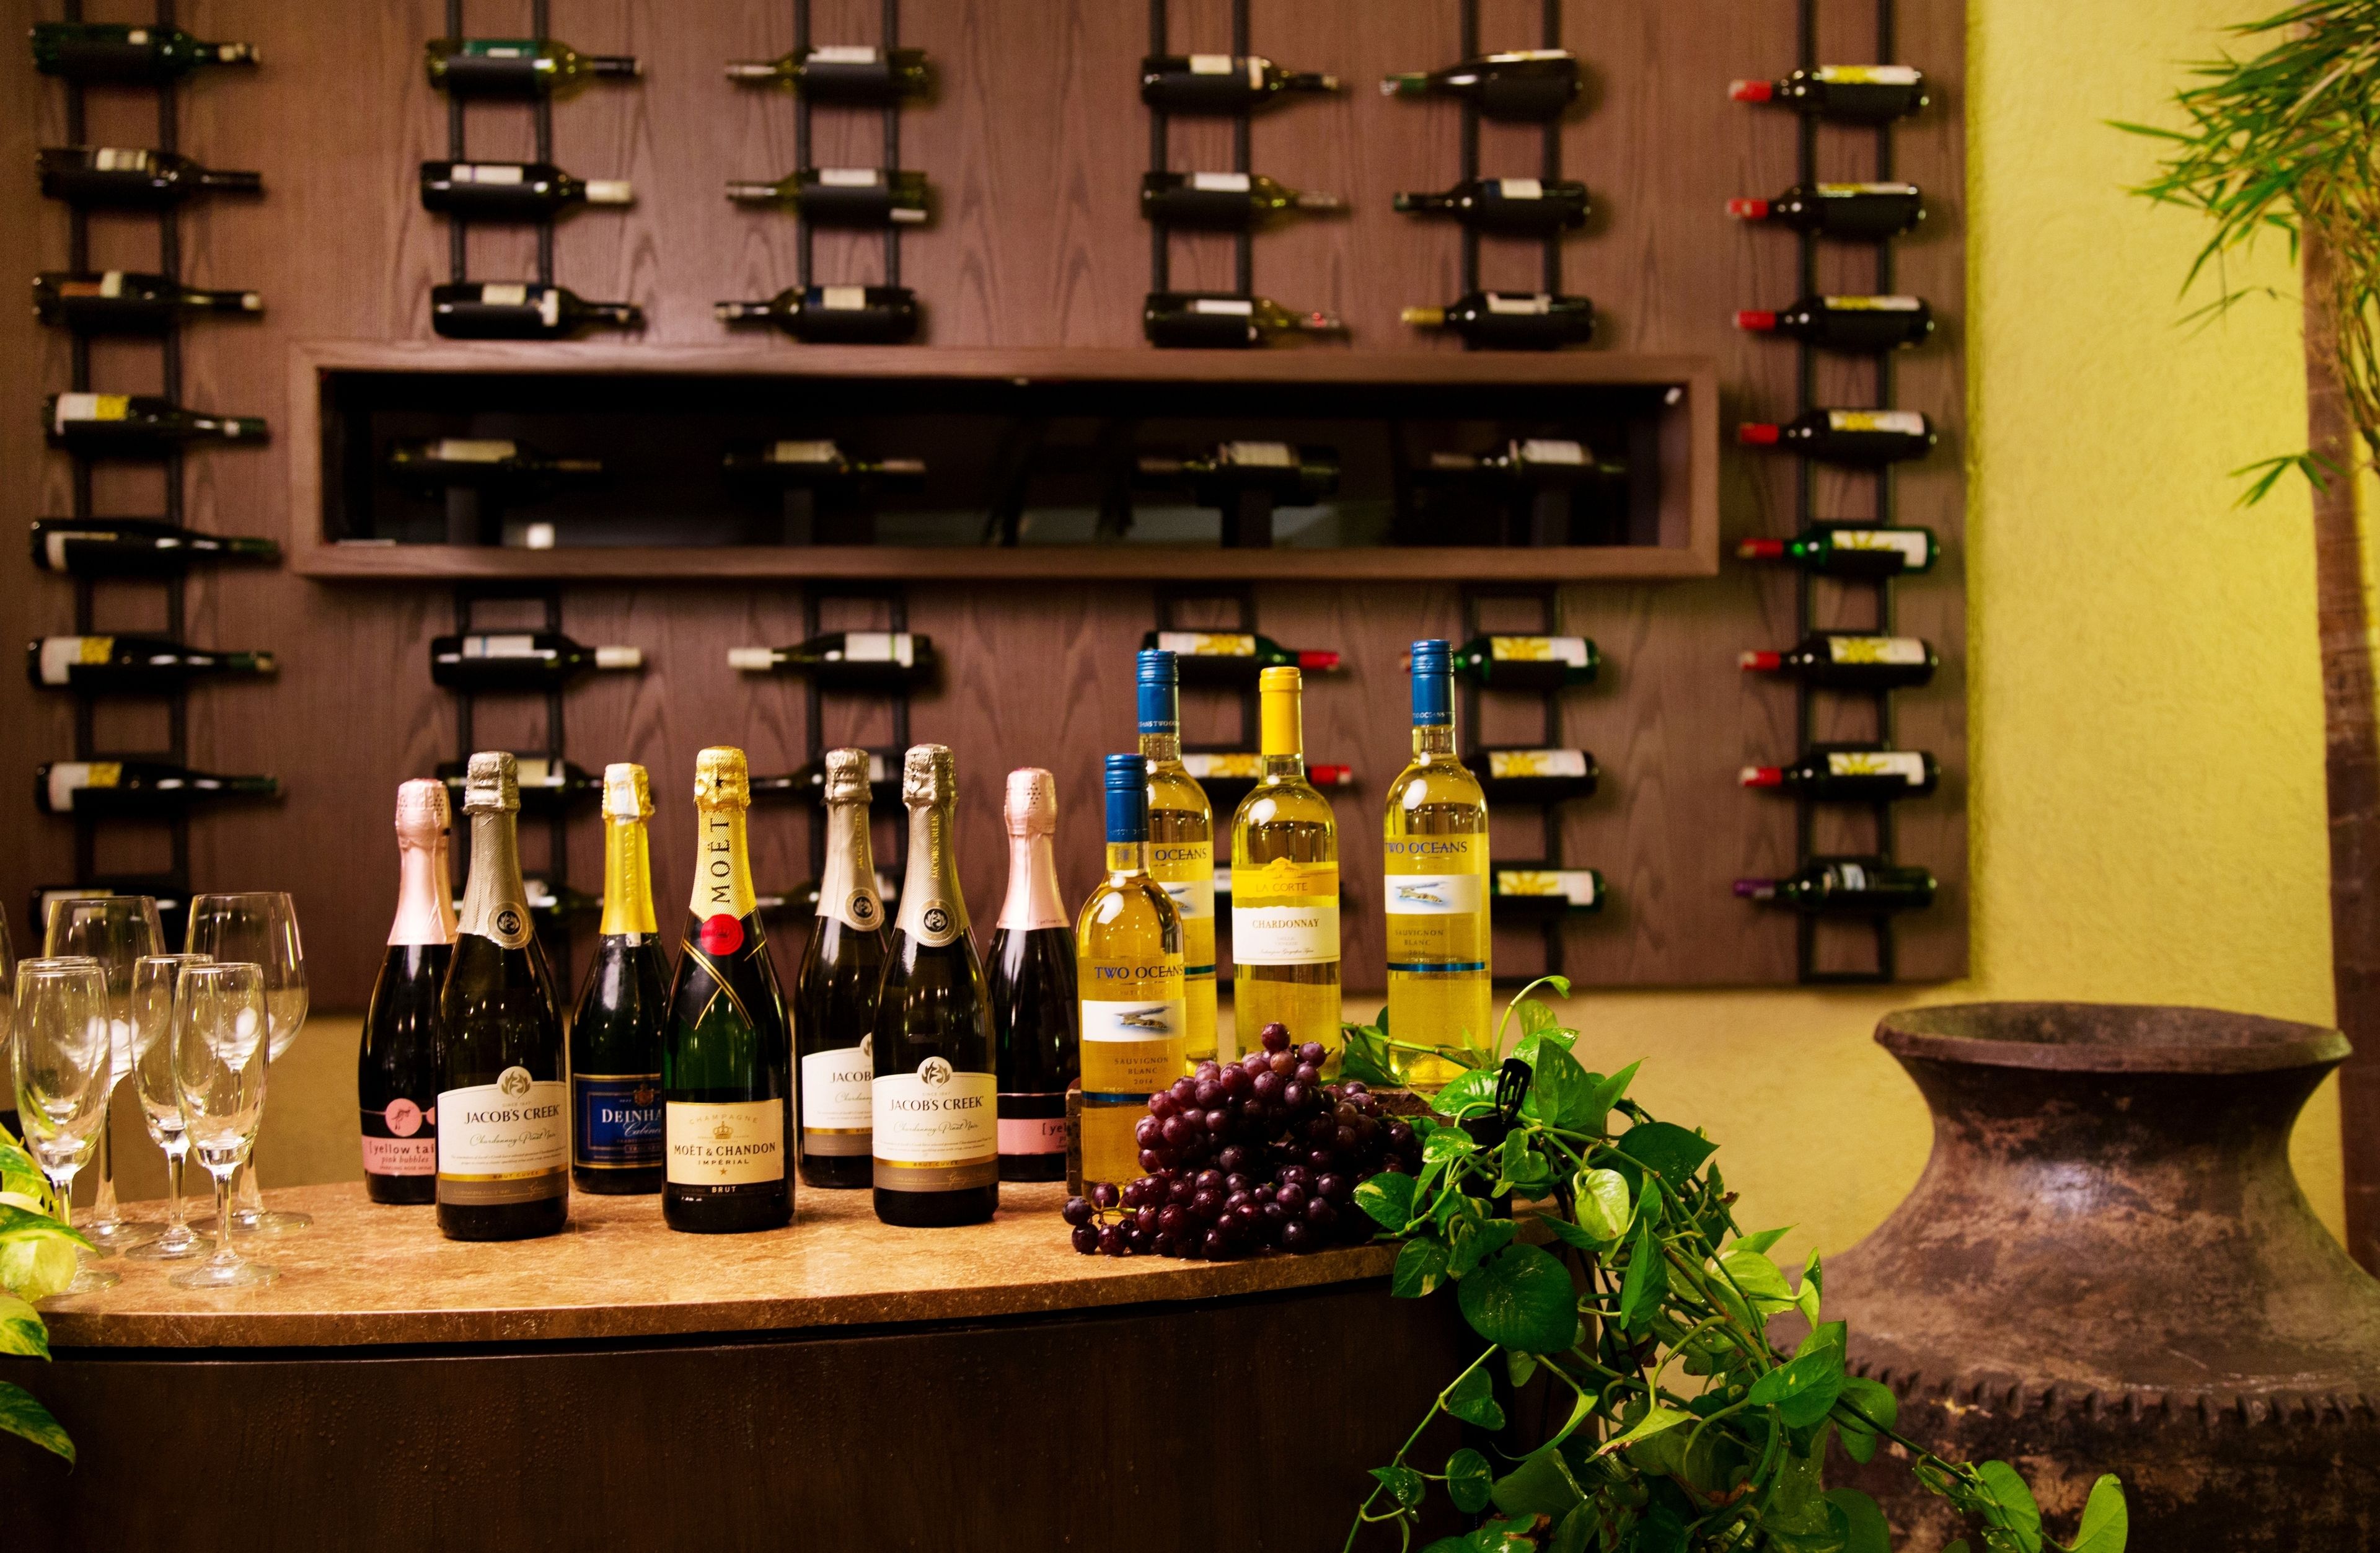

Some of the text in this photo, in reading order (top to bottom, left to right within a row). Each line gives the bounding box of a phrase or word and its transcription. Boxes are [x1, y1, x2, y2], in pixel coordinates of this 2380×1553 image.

[1409, 841, 1468, 853] OCEANS
[707, 818, 730, 903] MOËT
[1155, 848, 1207, 861] OCEANS
[1256, 882, 1308, 892] LA CORTE
[1253, 918, 1320, 929] CHARDONNAY
[1095, 965, 1183, 979] TWO OCEANS
[1114, 1057, 1168, 1065] SAUVIGNON
[830, 1071, 871, 1083] JACOB
[889, 1097, 982, 1111] JACOB'S CREEK
[464, 1105, 559, 1124] JACOB'S CREEK
[601, 1108, 661, 1123] DEINHA
[689, 1113, 758, 1125] CHAMPAGNE
[623, 1121, 661, 1136] Cabine
[894, 1121, 937, 1136] Chardonnay
[938, 1122, 964, 1134] Pinot
[470, 1133, 518, 1147] Chardonnay
[519, 1131, 543, 1144] Pinot
[416, 1144, 434, 1154] tai
[674, 1144, 703, 1156] MOËT
[706, 1148, 713, 1156] &
[716, 1142, 776, 1156] CHANDON
[382, 1155, 429, 1164] pink bubbles
